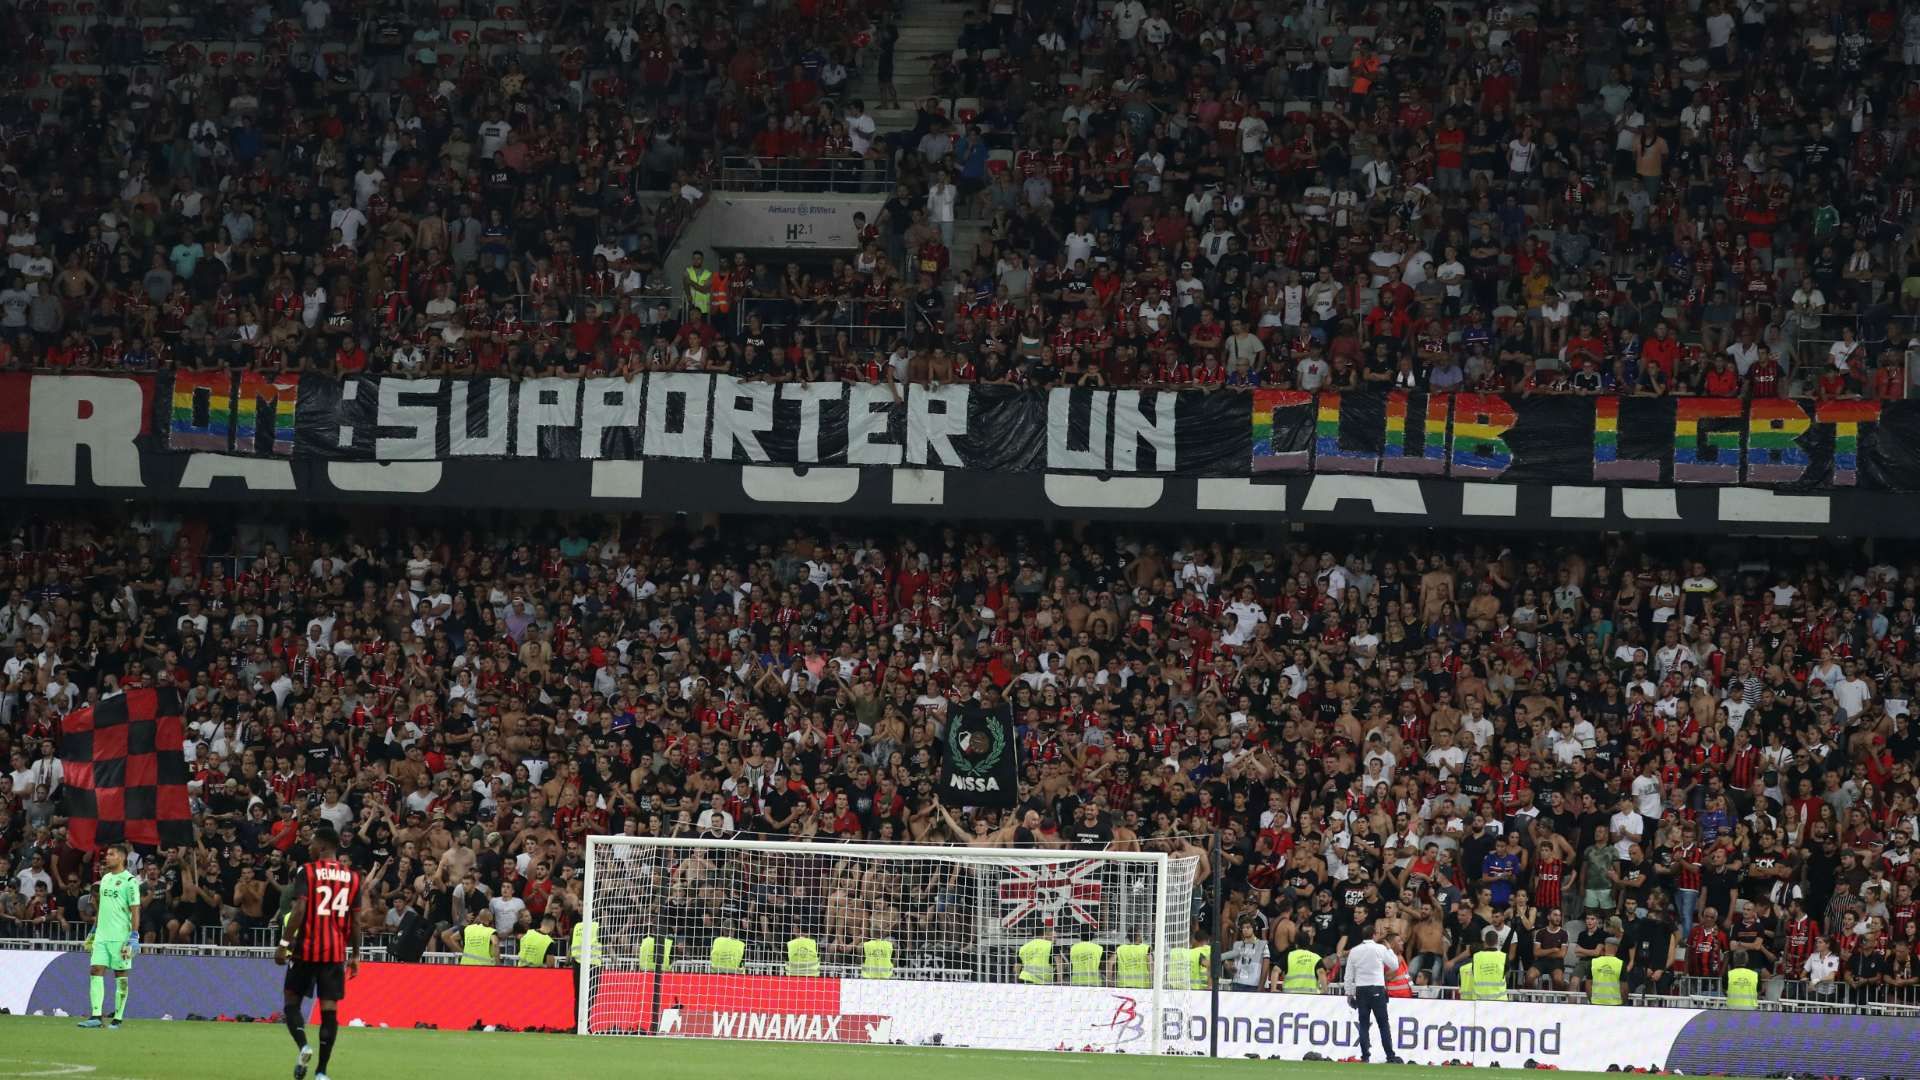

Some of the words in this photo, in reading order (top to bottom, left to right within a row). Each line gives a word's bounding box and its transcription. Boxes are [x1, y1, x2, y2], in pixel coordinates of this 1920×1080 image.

[768, 205, 795, 214] Allianz
[1045, 387, 1177, 472] UN
[1251, 390, 1518, 480] CLUB
[1592, 396, 1881, 485] LGBT
[950, 773, 999, 792] NISSA
[315, 868, 351, 882] PELMARD
[316, 885, 349, 917] 24
[711, 1010, 842, 1041] WINAMAX
[1163, 1007, 1372, 1047] Bonnaffoux
[1397, 1016, 1562, 1056] Brémond
